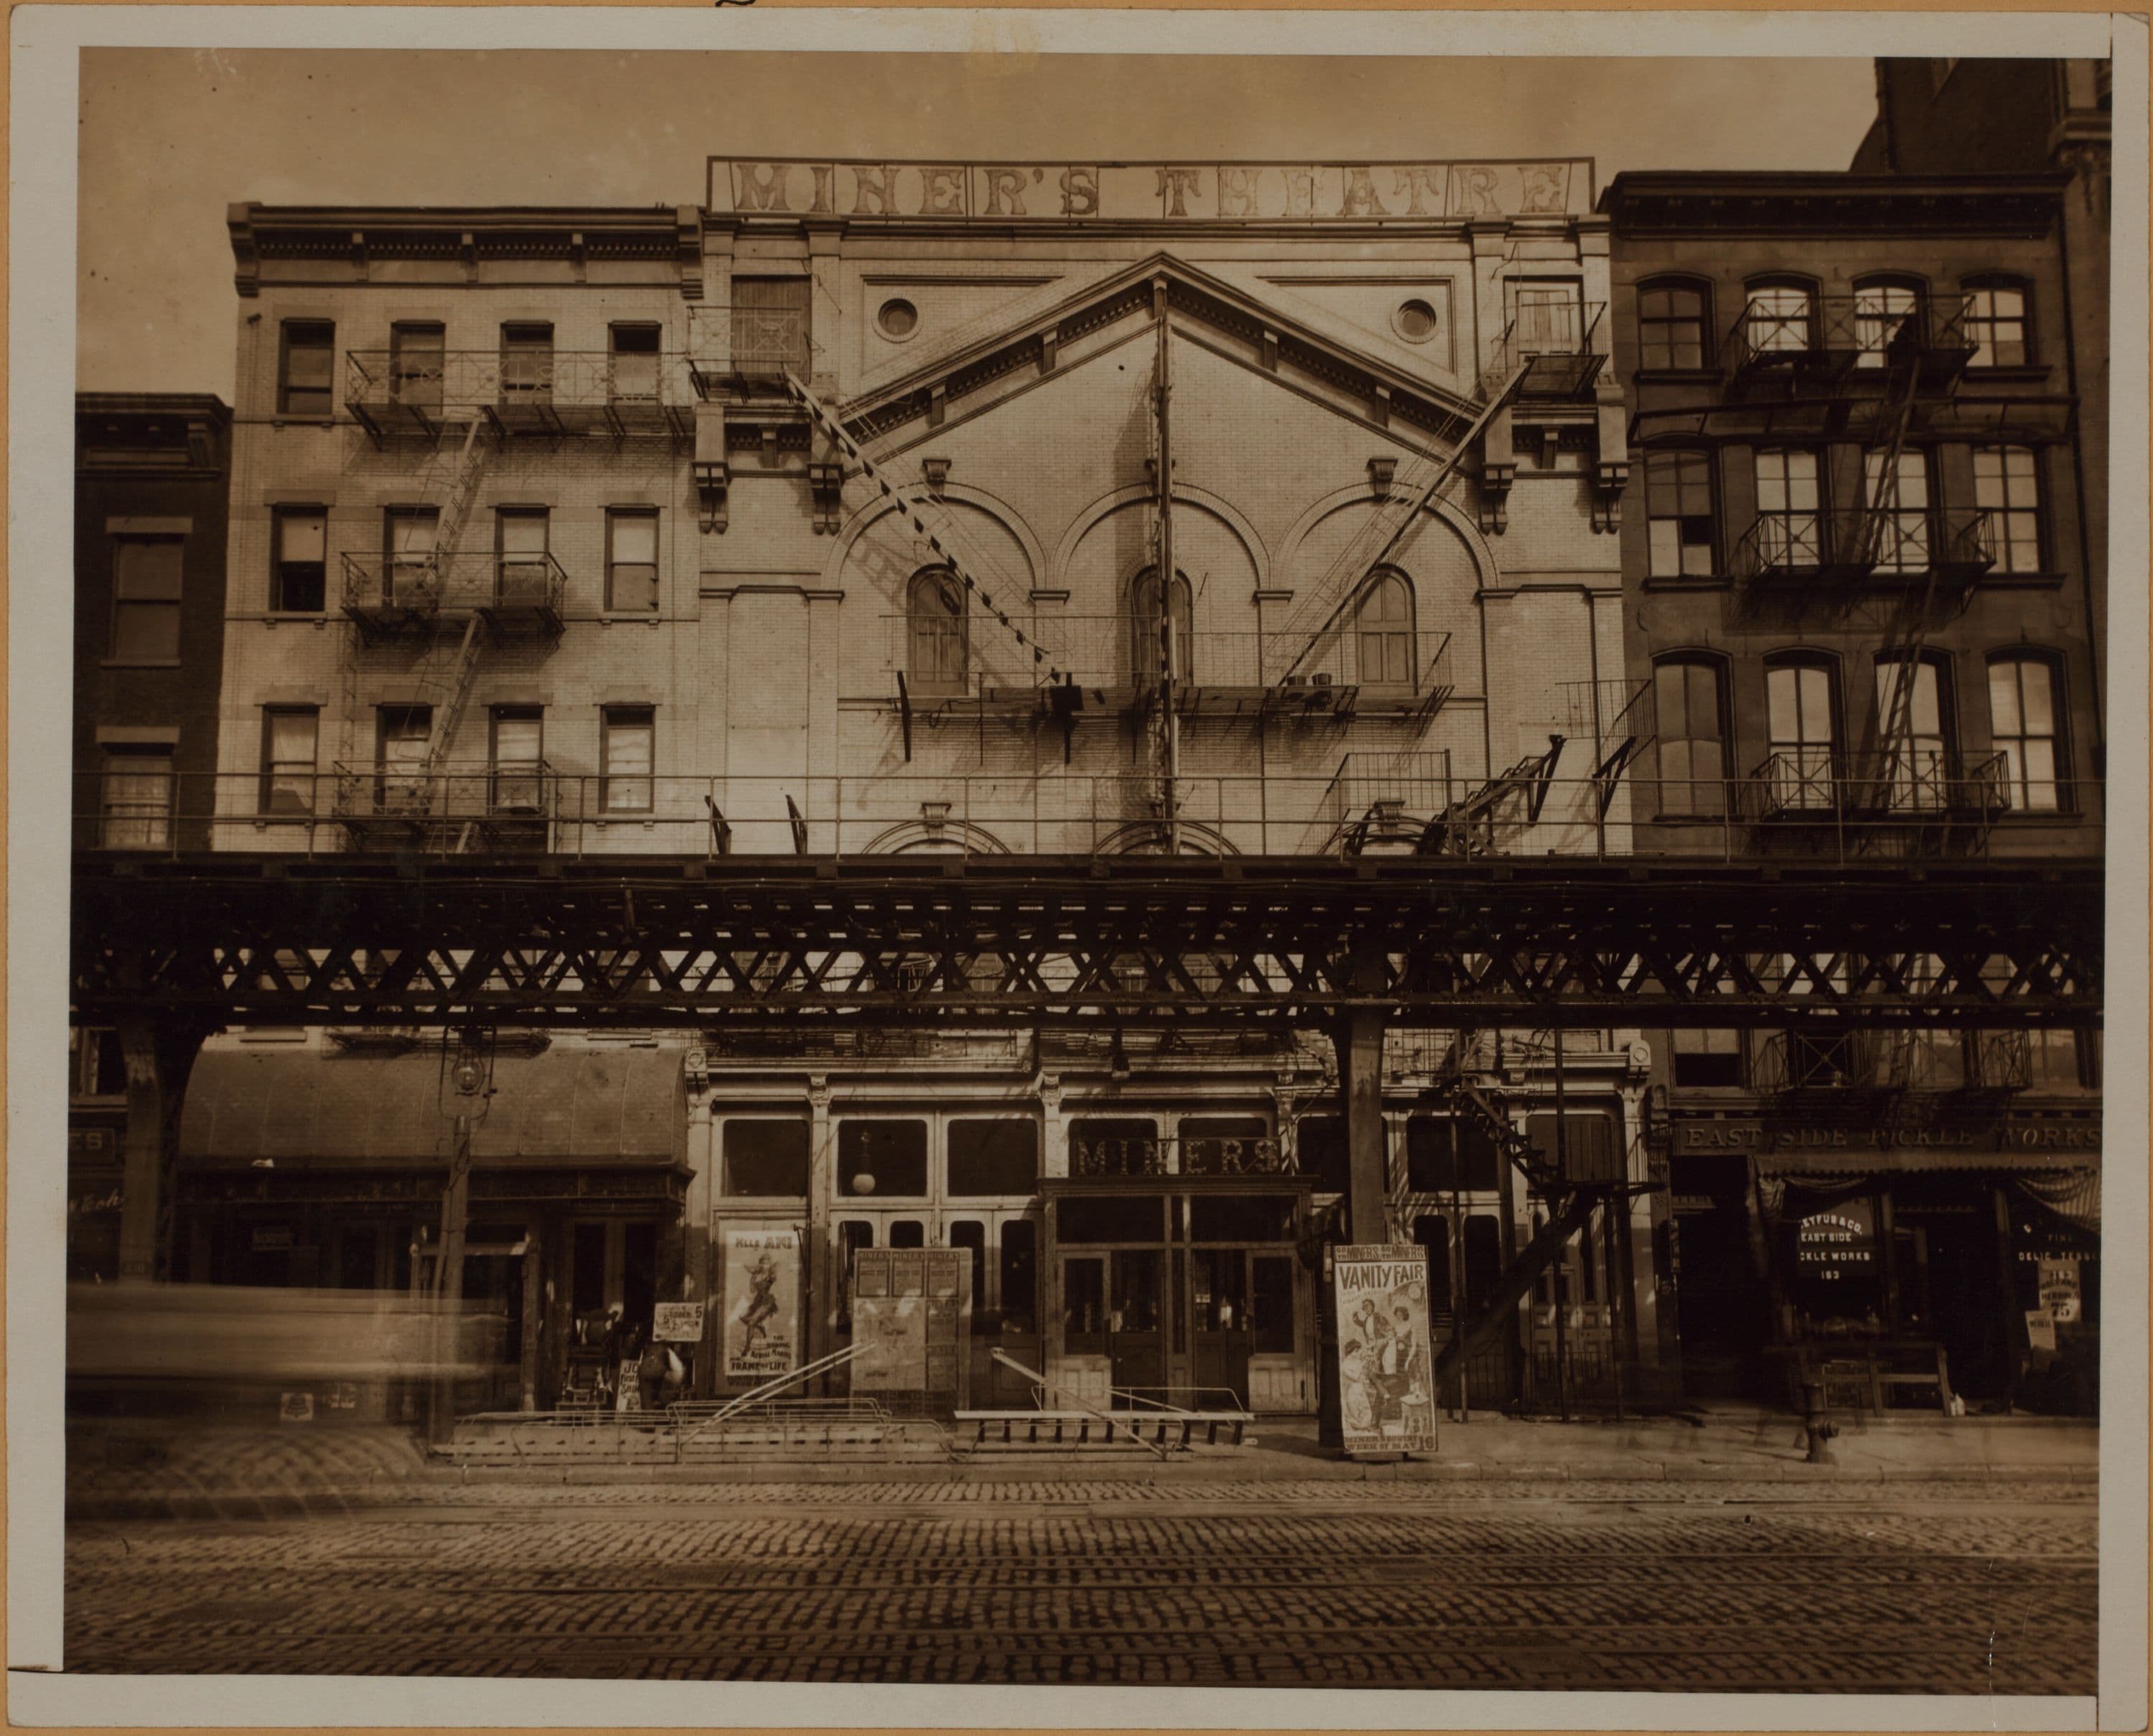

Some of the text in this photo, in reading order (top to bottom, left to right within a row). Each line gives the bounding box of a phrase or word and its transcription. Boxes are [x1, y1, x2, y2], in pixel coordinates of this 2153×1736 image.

[735, 163, 1565, 217] MINER'S THEATRE
[1686, 1128, 1762, 1147] EAST
[1778, 1128, 1849, 1146] SIDE
[1866, 1128, 1974, 1147] PICKLE
[1801, 1232, 1852, 1242] EAST SIDE
[1830, 1251, 1871, 1261] WORKS
[1339, 1264, 1424, 1291] VANITY FAIR
